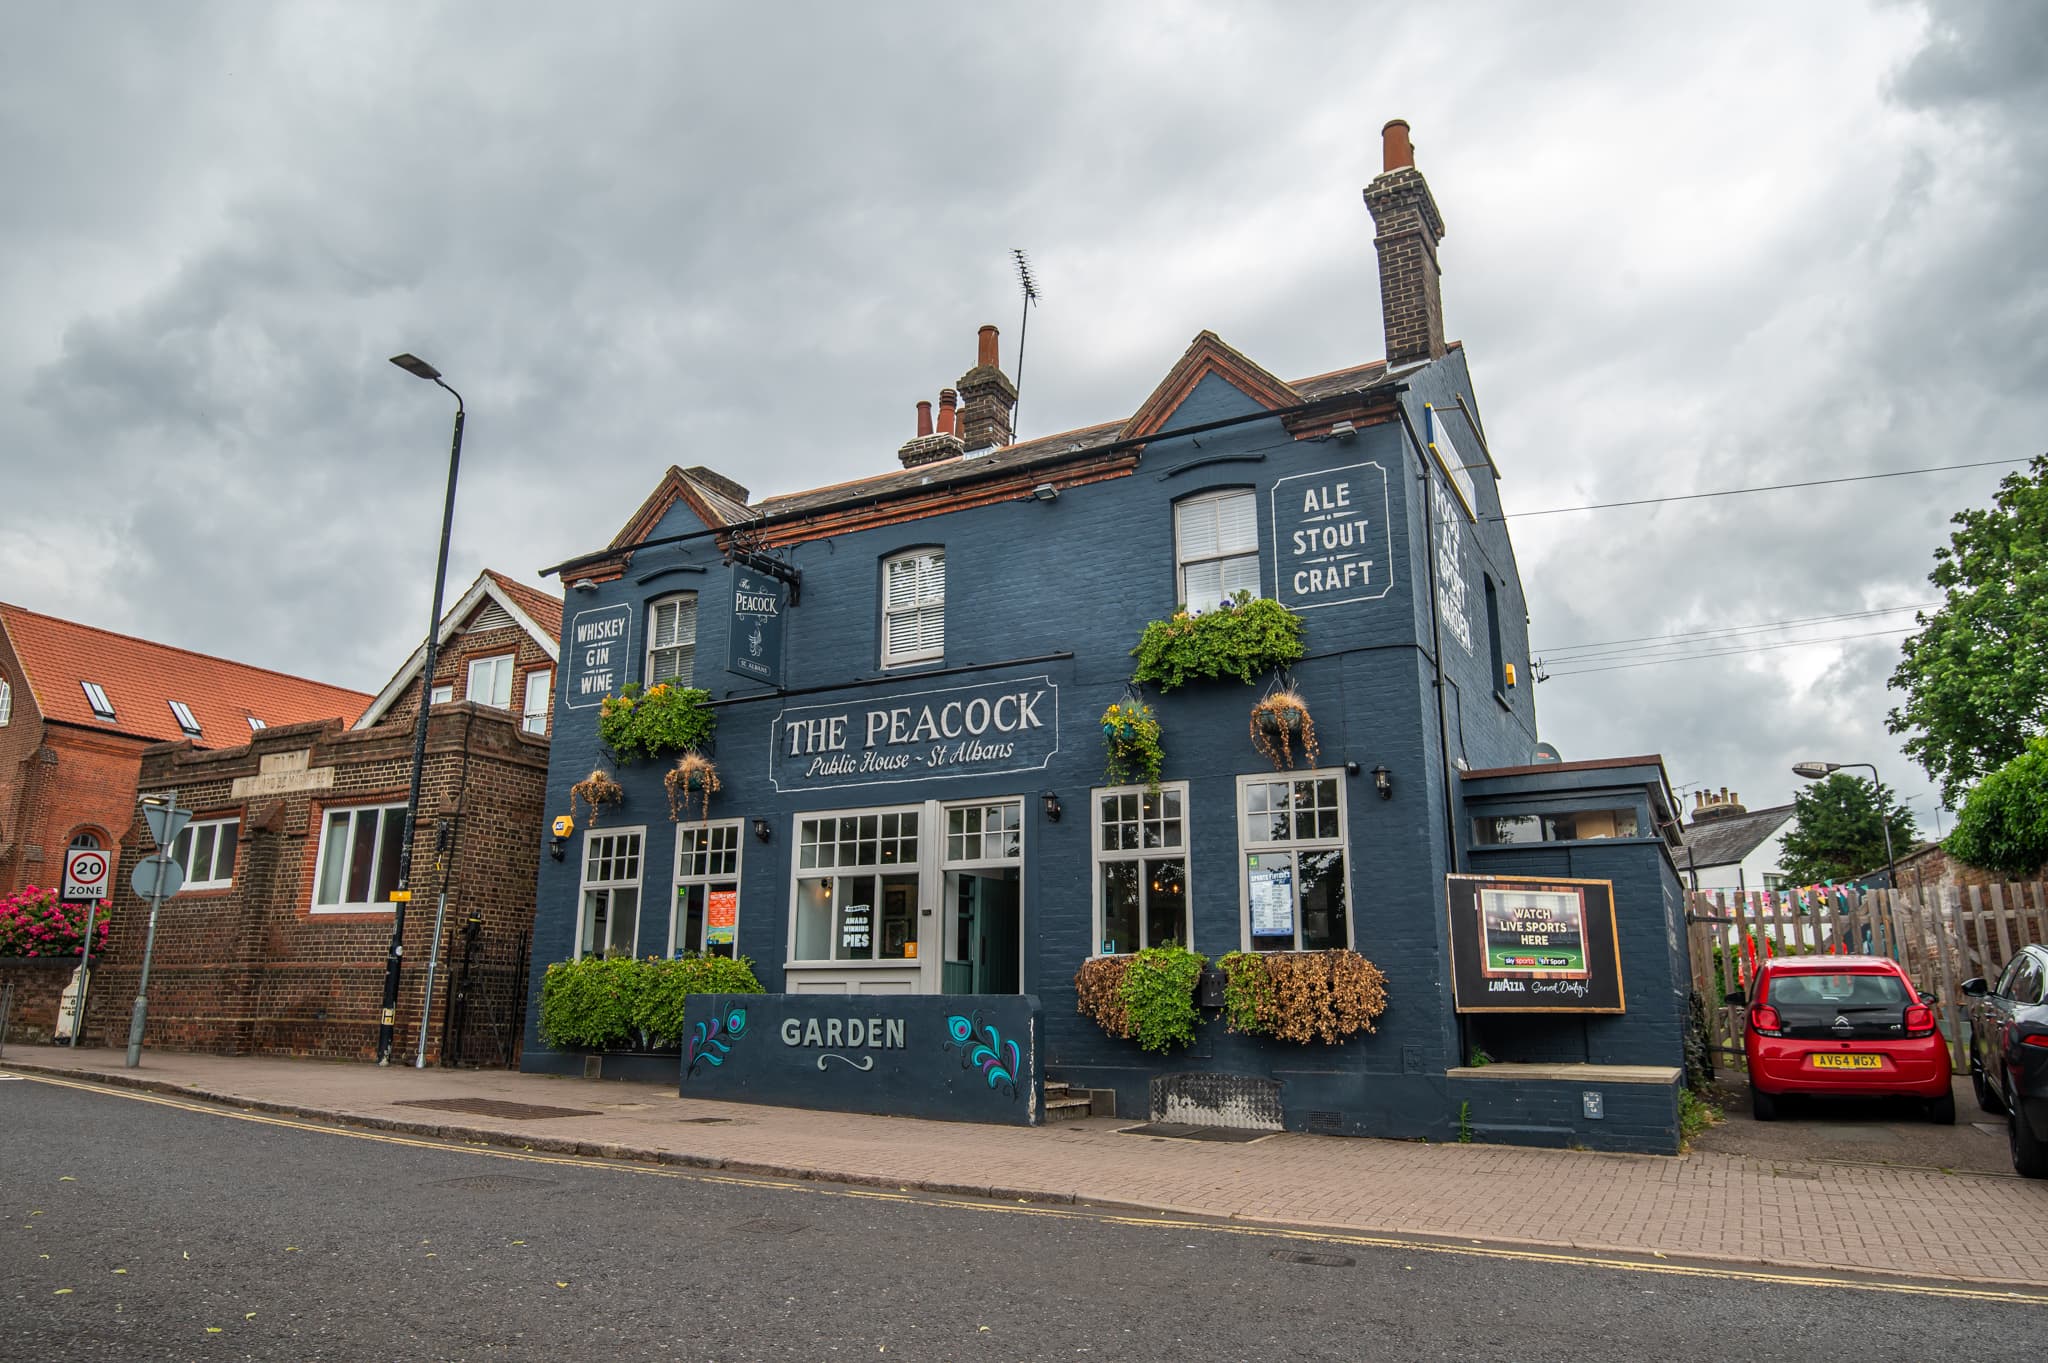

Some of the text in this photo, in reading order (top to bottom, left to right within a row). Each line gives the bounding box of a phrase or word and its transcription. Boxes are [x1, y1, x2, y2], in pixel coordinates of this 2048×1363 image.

[1304, 482, 1350, 512] ALE
[1434, 478, 1460, 544] FOOD
[1293, 520, 1368, 555] STOUT
[1294, 560, 1373, 594] CRAFT
[736, 592, 779, 614] PEACOCK
[578, 617, 625, 642] WHISKEY
[586, 647, 609, 666] GIN
[581, 673, 613, 694] WINE
[786, 690, 1046, 756] THE PEACOCK
[805, 754, 857, 777] Public
[860, 751, 909, 773] House
[927, 745, 948, 767] St
[950, 740, 1014, 764] Albans
[76, 861, 102, 875] 20
[68, 886, 103, 895] ZONE
[1514, 908, 1551, 919] WATCH
[1500, 921, 1567, 932] LIVE SPORTS
[842, 934, 870, 947] PIES
[1521, 935, 1549, 945] HERE
[1505, 957, 1515, 965] sky
[1515, 957, 1535, 965] sports
[1550, 958, 1566, 966] Sport
[1488, 979, 1526, 992] LAVAZZA
[781, 1018, 905, 1048] GARDEN
[1820, 1056, 1877, 1067] AV64 WGX
